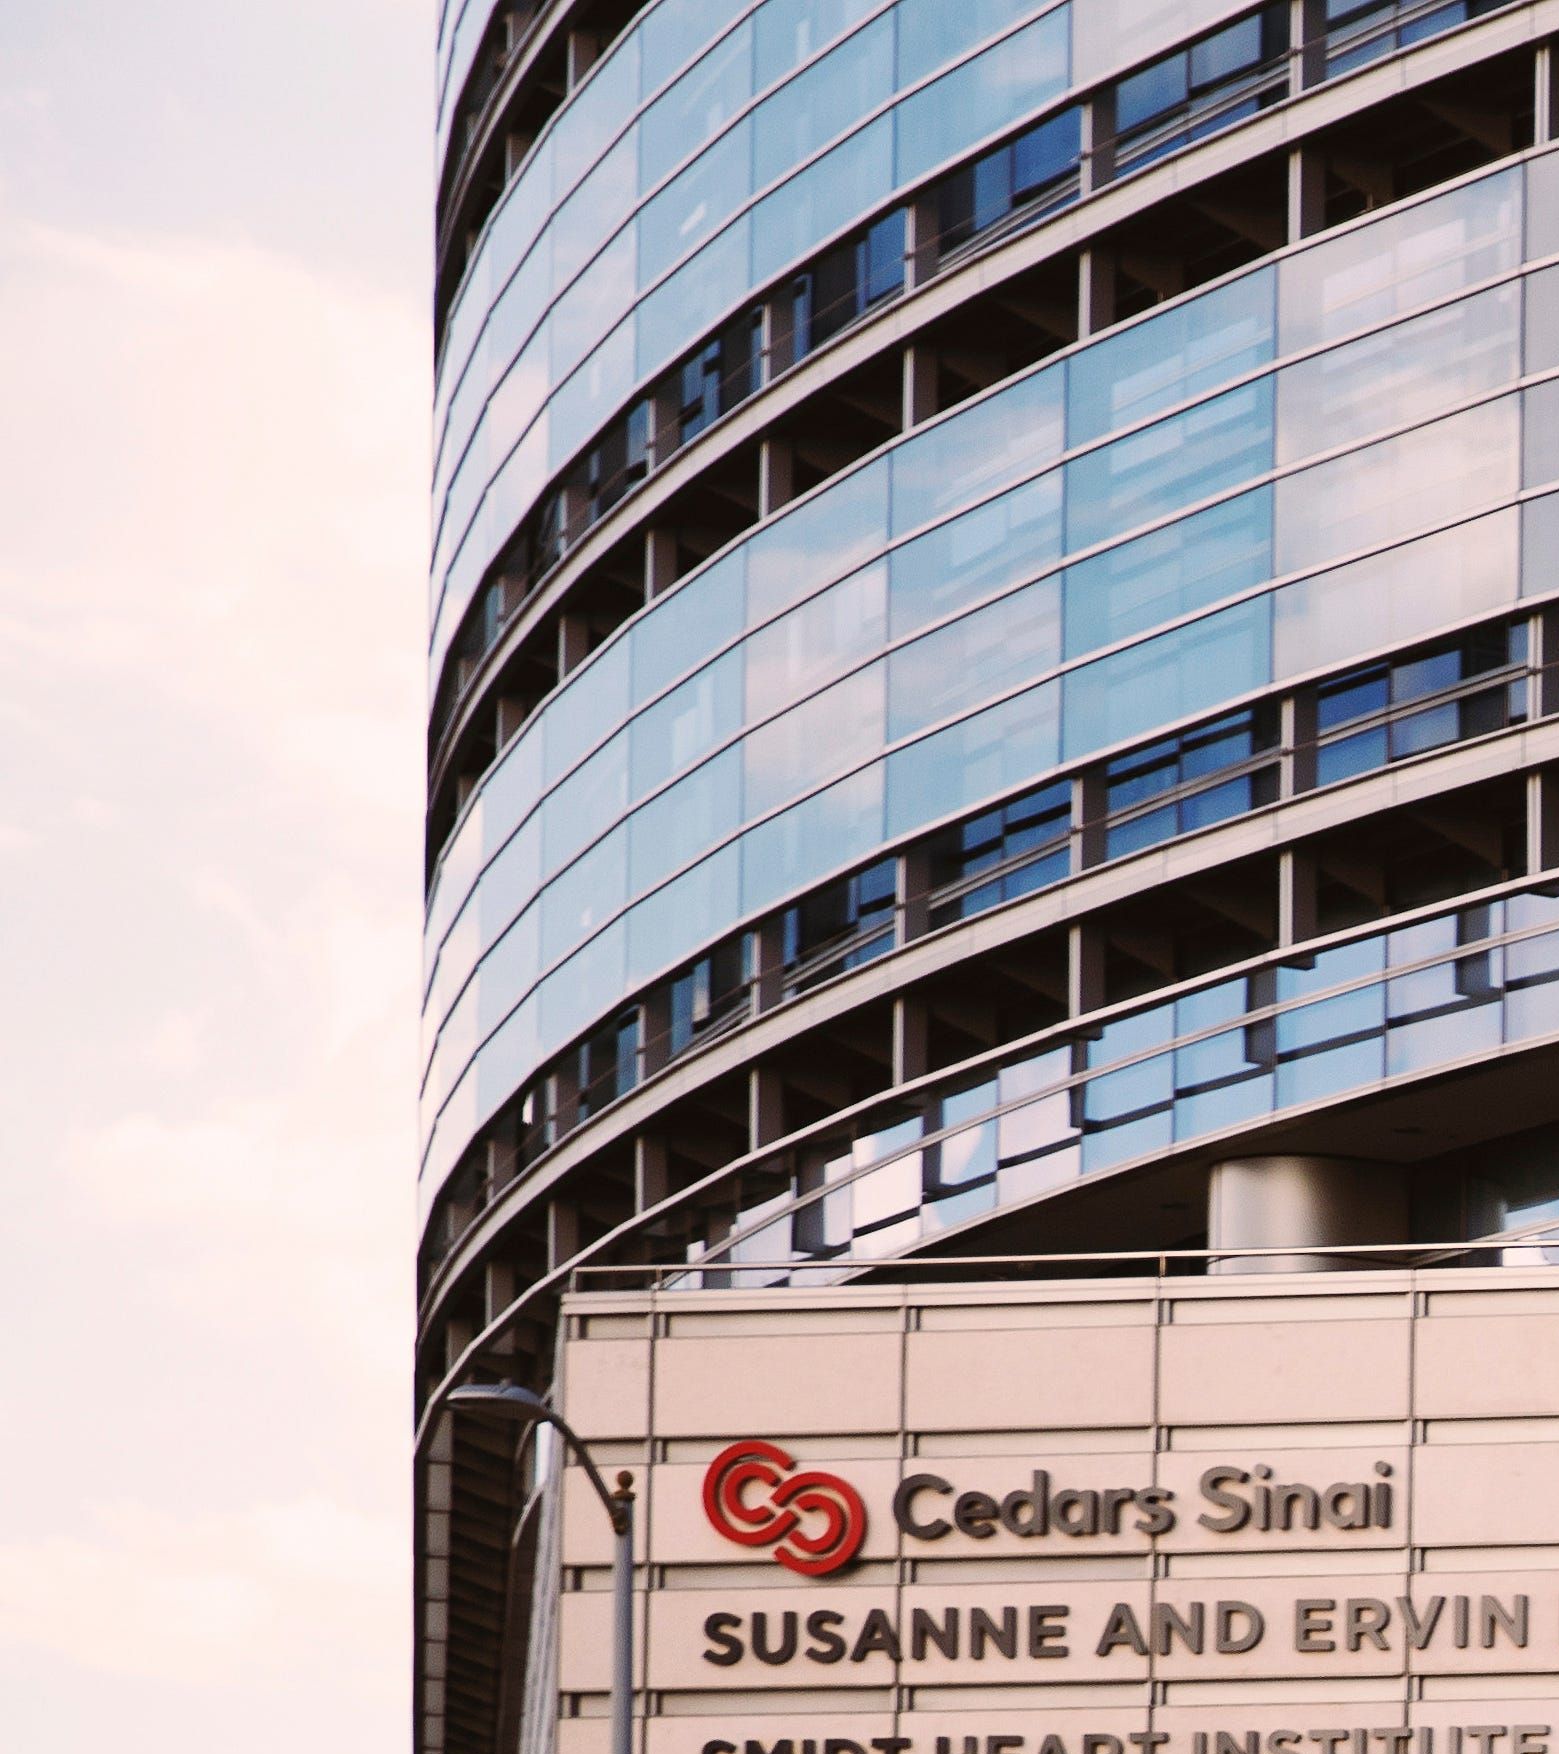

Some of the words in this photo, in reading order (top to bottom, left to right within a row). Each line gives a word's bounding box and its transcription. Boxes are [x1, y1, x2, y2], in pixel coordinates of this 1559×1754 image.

[894, 1469, 1175, 1541] Cedars
[1198, 1461, 1393, 1534] Sinai
[702, 1605, 1071, 1667] SUSANNE
[1096, 1600, 1265, 1657] AND
[1293, 1594, 1530, 1652] ERVIN
